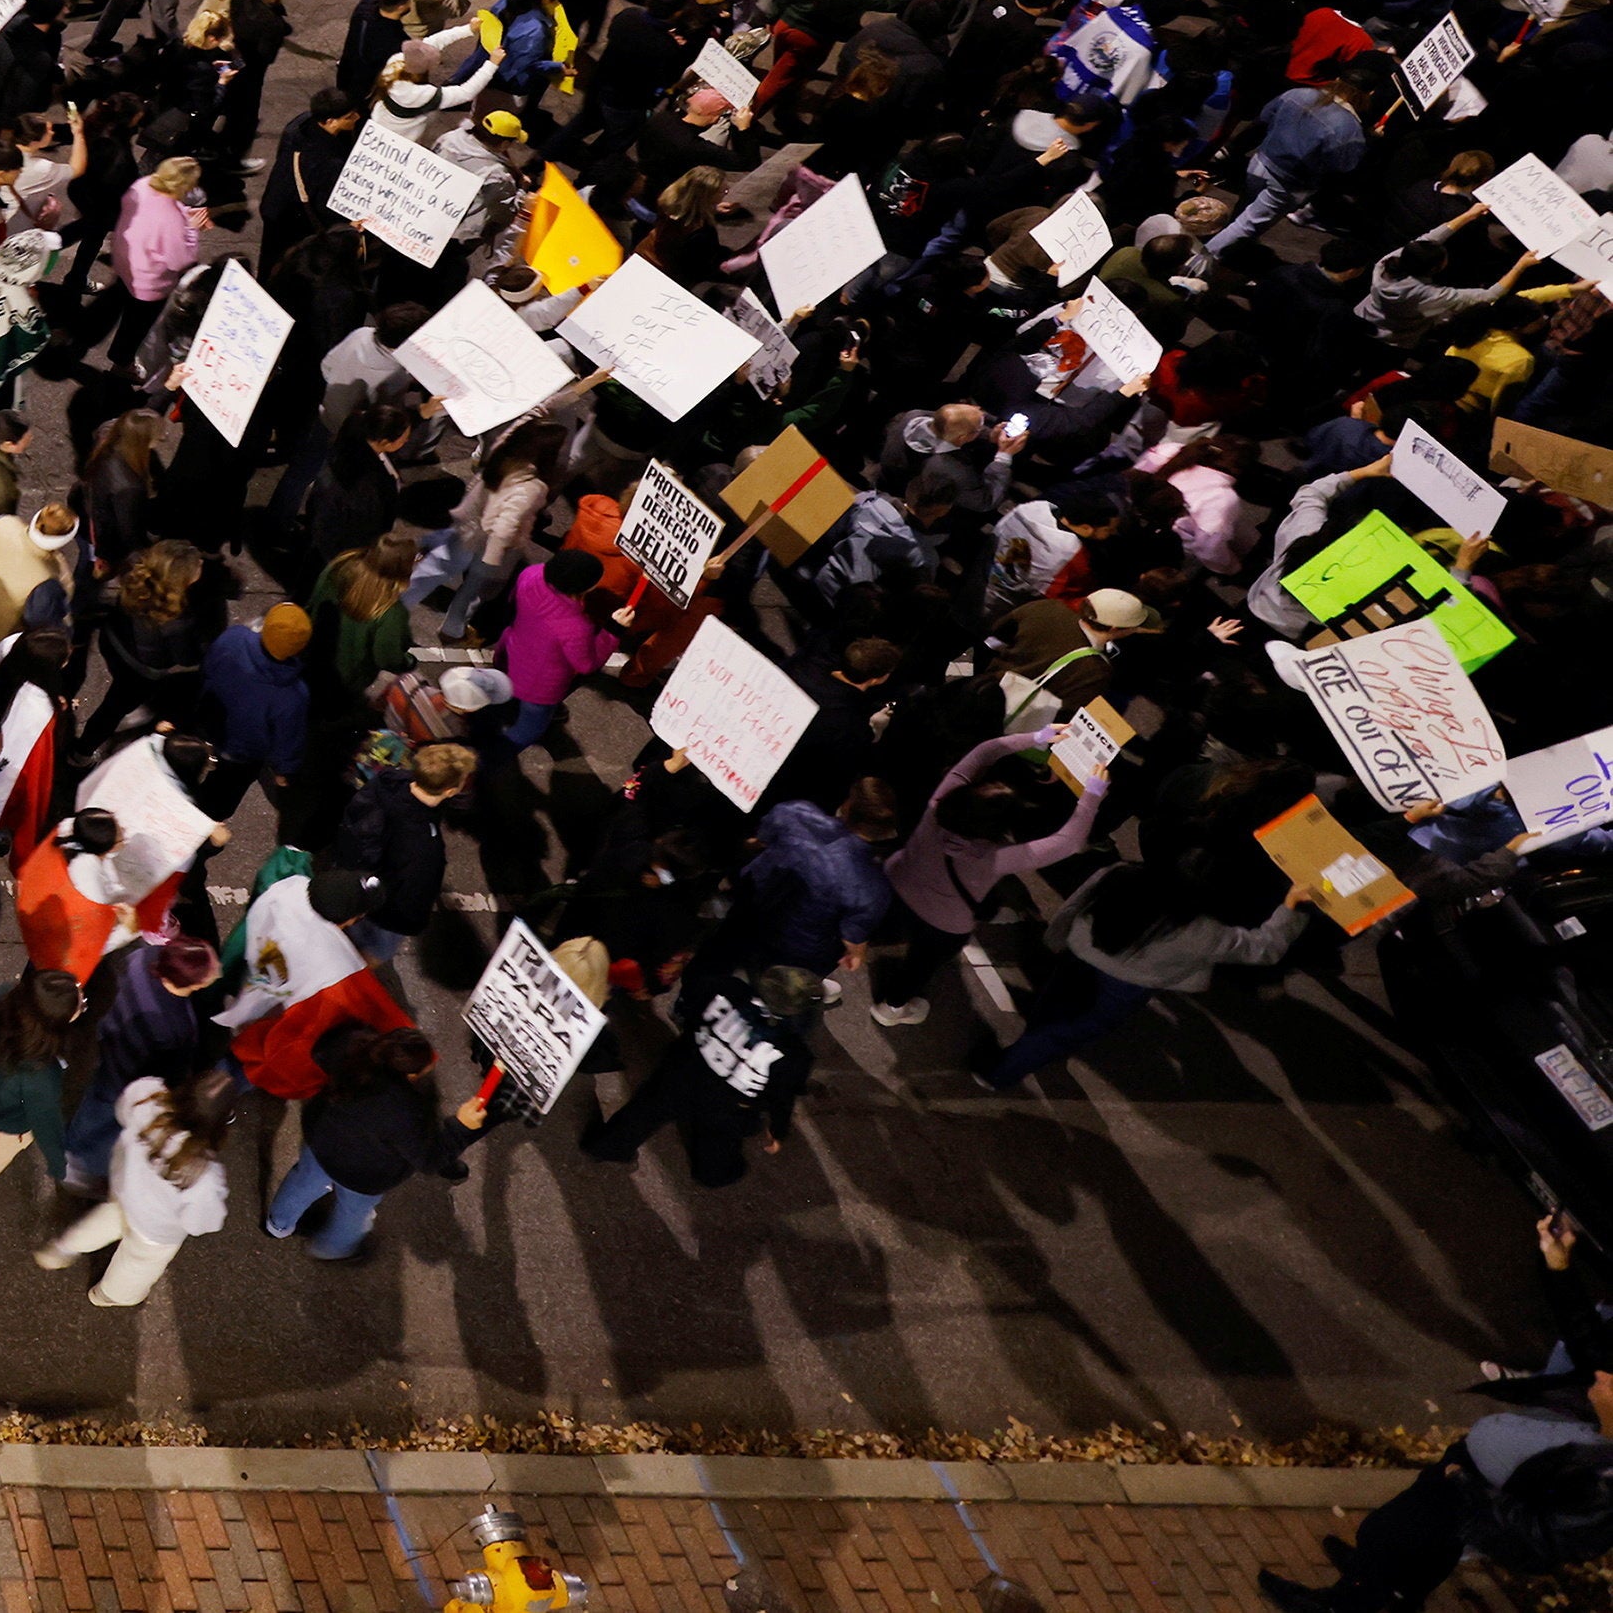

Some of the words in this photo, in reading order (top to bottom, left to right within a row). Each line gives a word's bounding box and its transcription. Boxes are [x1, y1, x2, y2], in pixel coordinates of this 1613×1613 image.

[1396, 59, 1440, 103] BORDERS!
[1412, 55, 1432, 75] HAS
[1422, 71, 1439, 88] NO
[1415, 37, 1461, 83] STRUGGLE
[347, 147, 417, 196] deportation
[411, 184, 427, 202] is
[424, 193, 440, 209] a
[358, 125, 415, 169] Behind
[411, 155, 453, 193] every
[327, 196, 366, 225] home
[334, 181, 374, 211] Parent
[371, 202, 404, 229] didn't
[338, 165, 379, 197] asking
[373, 184, 400, 208] why
[395, 196, 427, 221] their
[1534, 176, 1571, 211] PAPA
[1052, 225, 1093, 270] ICE
[629, 311, 676, 343] OUT
[651, 290, 707, 332] ICE
[1094, 307, 1134, 347] COME
[1097, 292, 1145, 339] ICE
[580, 328, 679, 397] RALEIGH
[621, 328, 657, 356] OF
[189, 336, 229, 375] ICE
[224, 371, 252, 397] OUT
[633, 494, 708, 556] DERECHO
[634, 463, 728, 541] PROTESTAR
[650, 491, 674, 513] ES
[669, 509, 702, 536] UN
[619, 521, 698, 590] DELITO
[637, 516, 665, 540] NO
[659, 537, 693, 566] UN
[701, 657, 737, 689] NOT
[1367, 613, 1494, 747] Chinga
[1444, 712, 1509, 778] La
[658, 688, 693, 720] NO
[687, 713, 748, 765] PEACE
[1075, 712, 1099, 733] NO
[1092, 730, 1119, 754] ICE
[1296, 641, 1358, 705] ICE
[1338, 698, 1387, 750] OUT
[1369, 739, 1411, 782] OF
[1564, 773, 1610, 817] OUT
[498, 964, 575, 1056] PARA
[482, 986, 566, 1089] CONTRA
